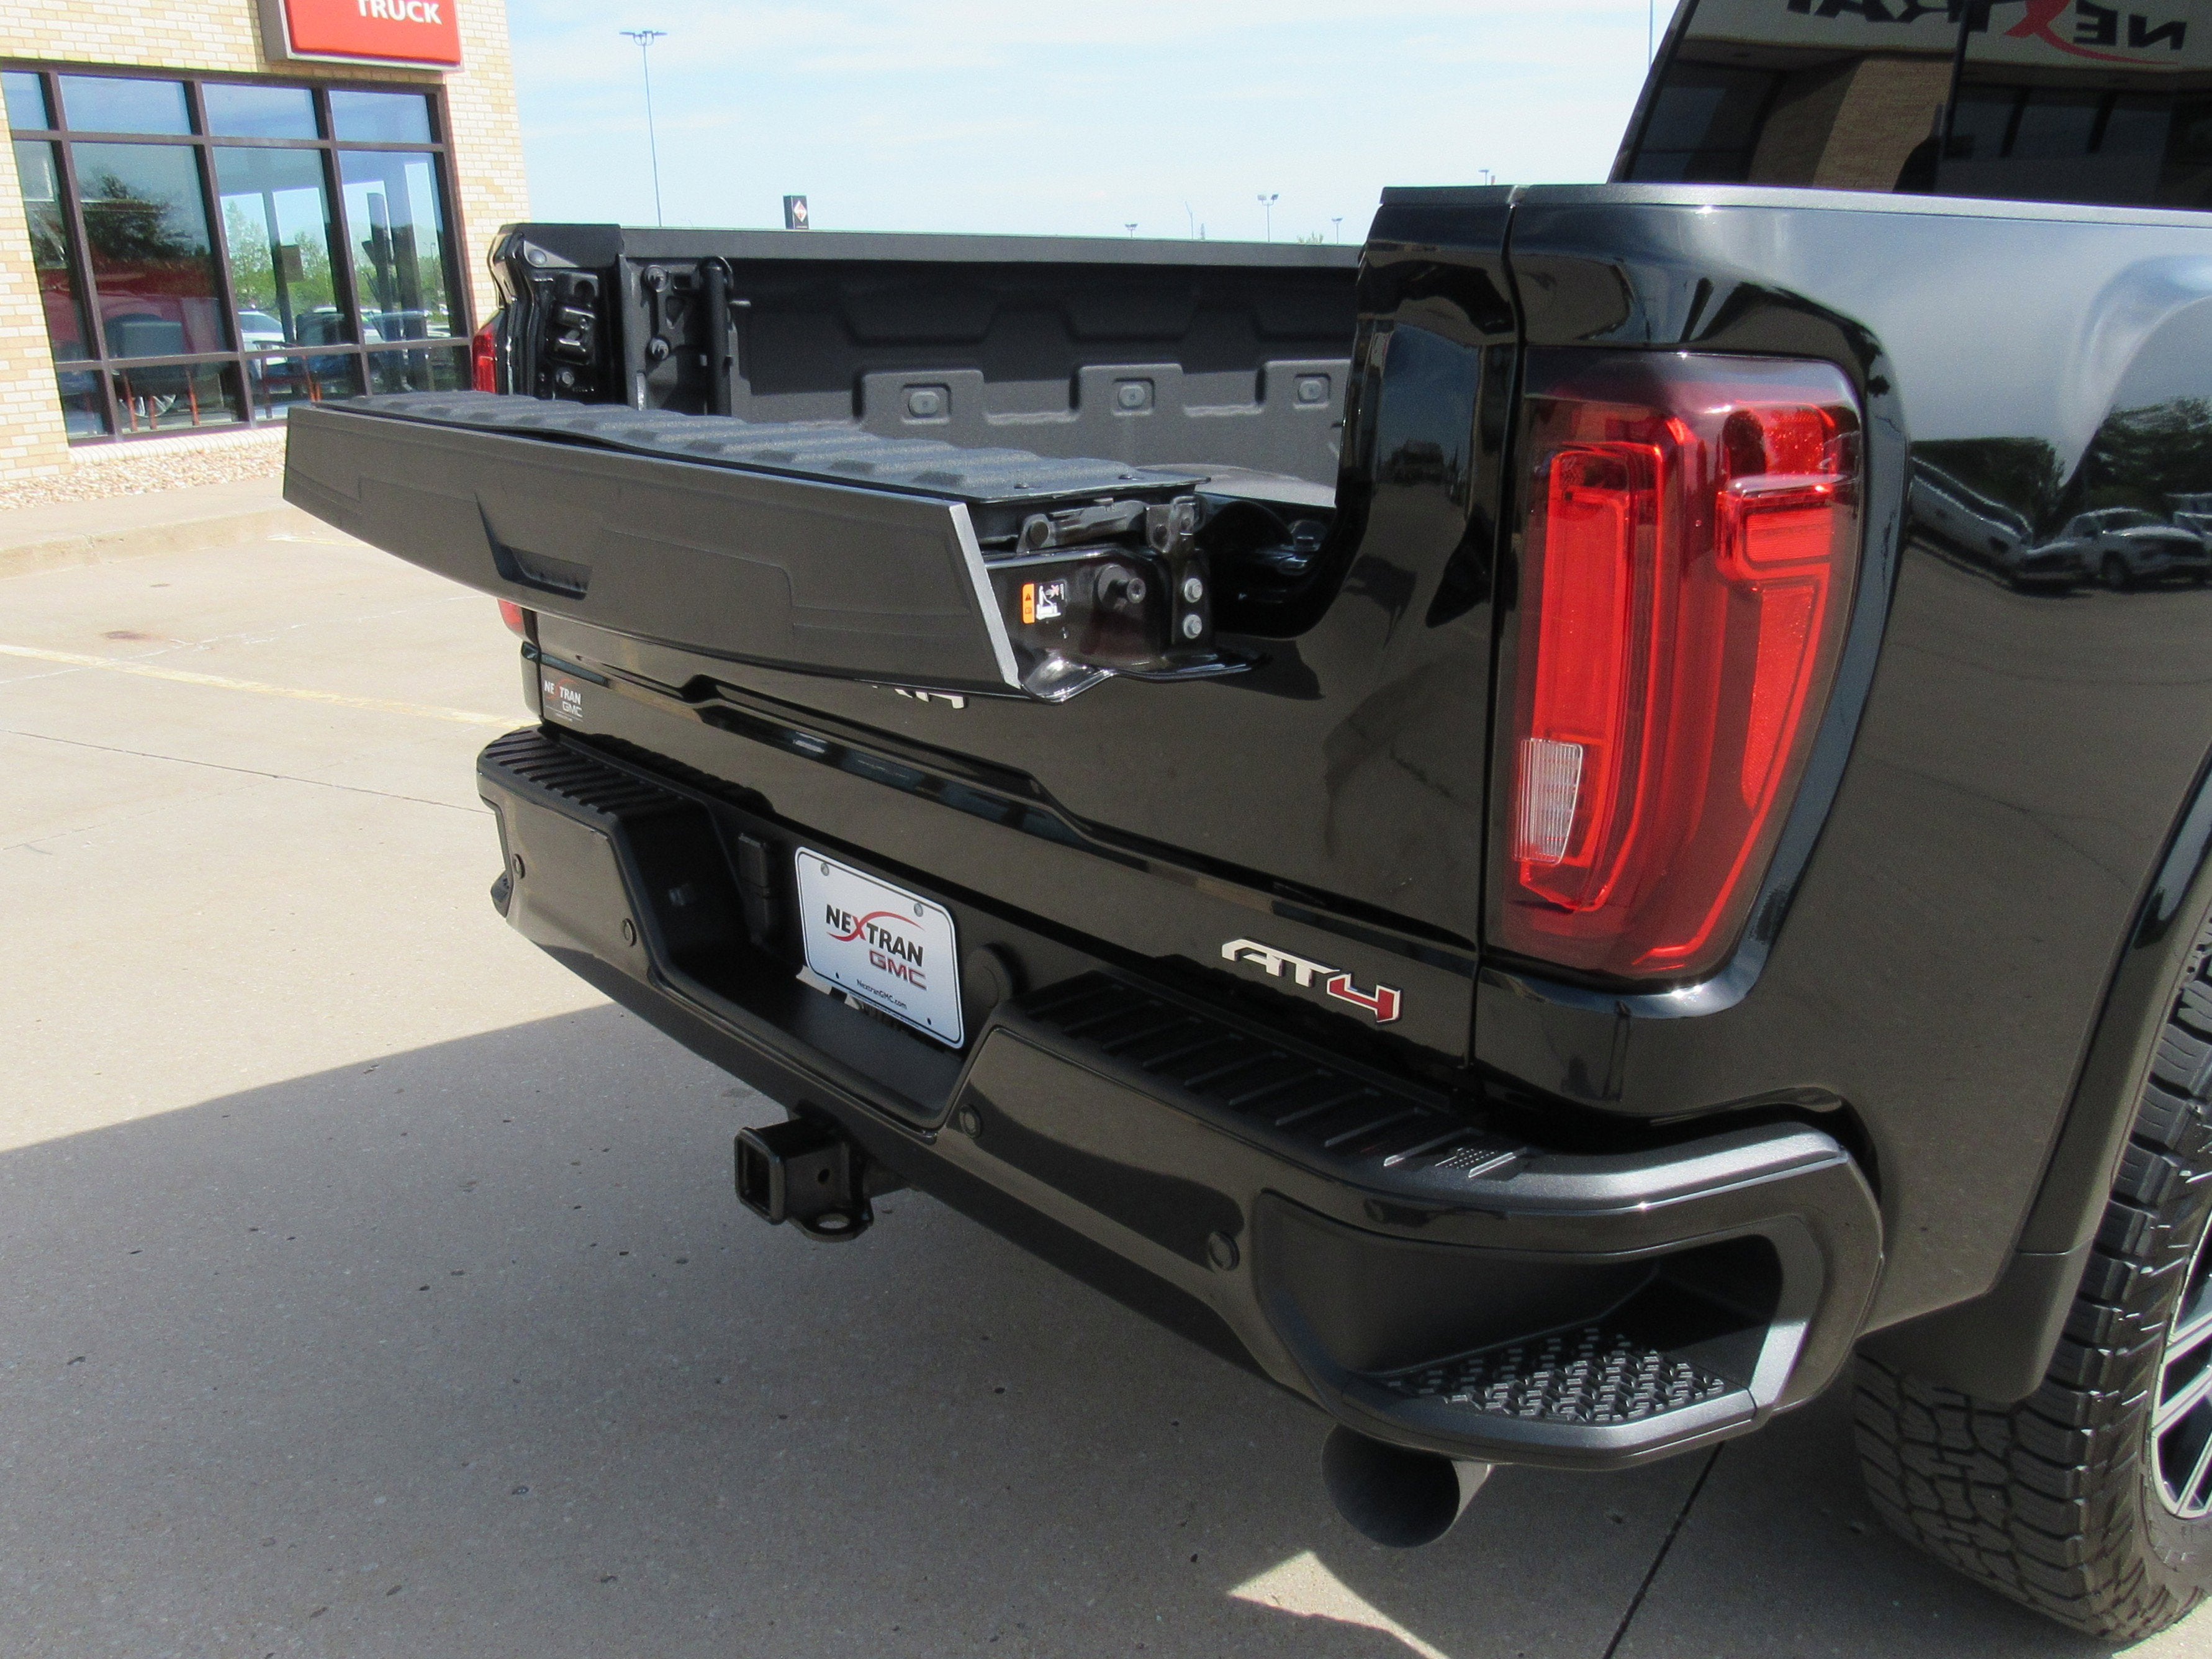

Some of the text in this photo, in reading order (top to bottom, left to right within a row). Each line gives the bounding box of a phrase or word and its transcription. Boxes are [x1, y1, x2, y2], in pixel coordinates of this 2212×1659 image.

[357, 0, 443, 25] TRUCK
[562, 701, 583, 718] GMC
[826, 904, 924, 967] NEXTRAN
[869, 949, 928, 992] GMC
[1221, 938, 1401, 1023] AT4
